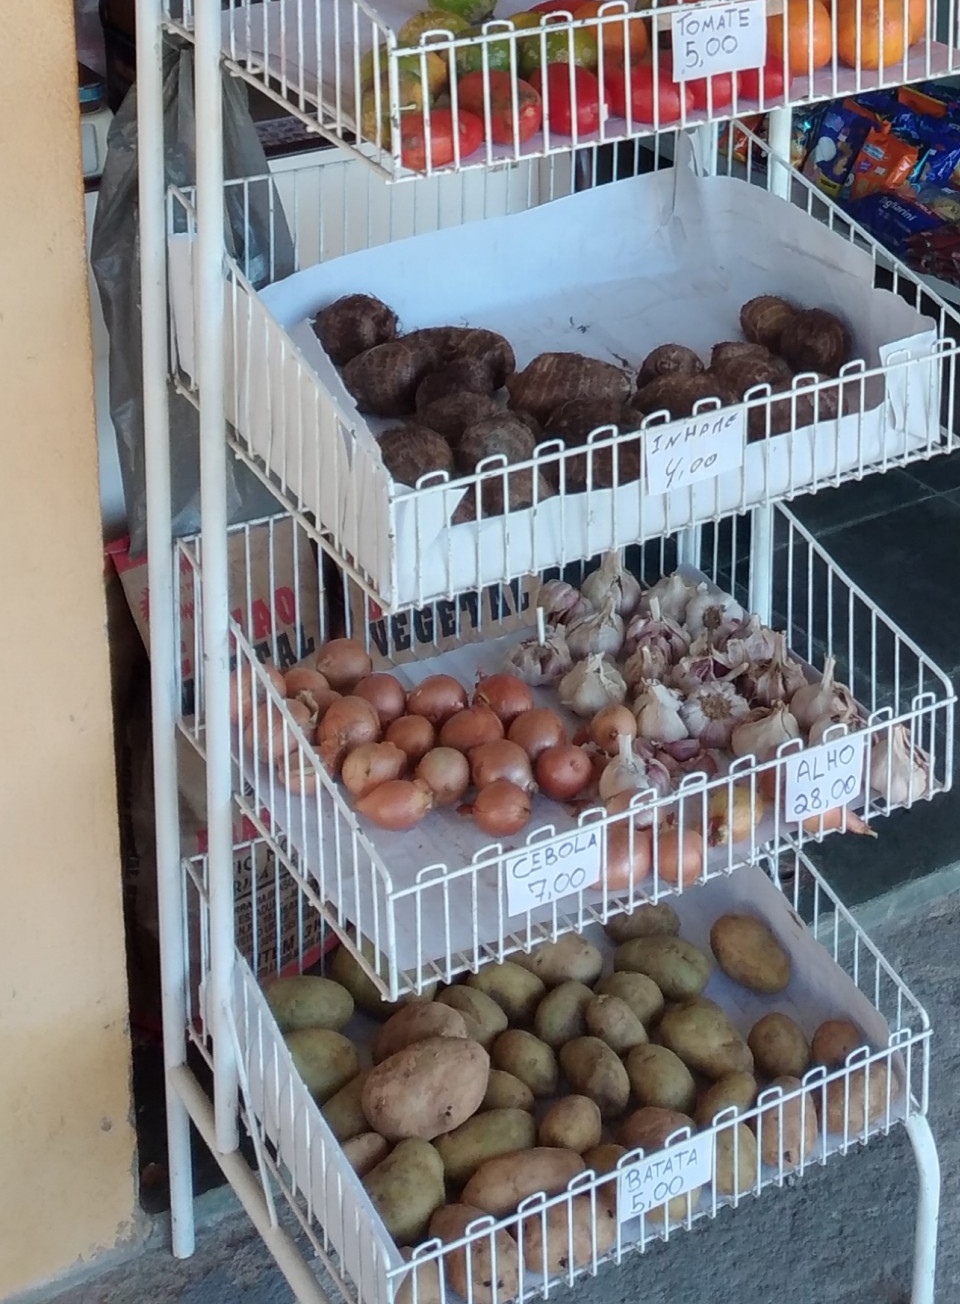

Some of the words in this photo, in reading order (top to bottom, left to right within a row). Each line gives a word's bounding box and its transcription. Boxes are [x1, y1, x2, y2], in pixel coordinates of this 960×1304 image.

[677, 8, 751, 37] TOMATE
[685, 35, 738, 69] 5,00
[652, 412, 740, 455] INHAME
[666, 453, 718, 488] 4,00
[369, 584, 531, 657] VEGETAL
[797, 744, 854, 783] ALHO
[794, 775, 856, 814] 28,00
[513, 833, 598, 878] CEBOLA
[528, 867, 586, 902] 7,00
[625, 1147, 698, 1192] BATATA
[630, 1176, 684, 1214] 5,00
